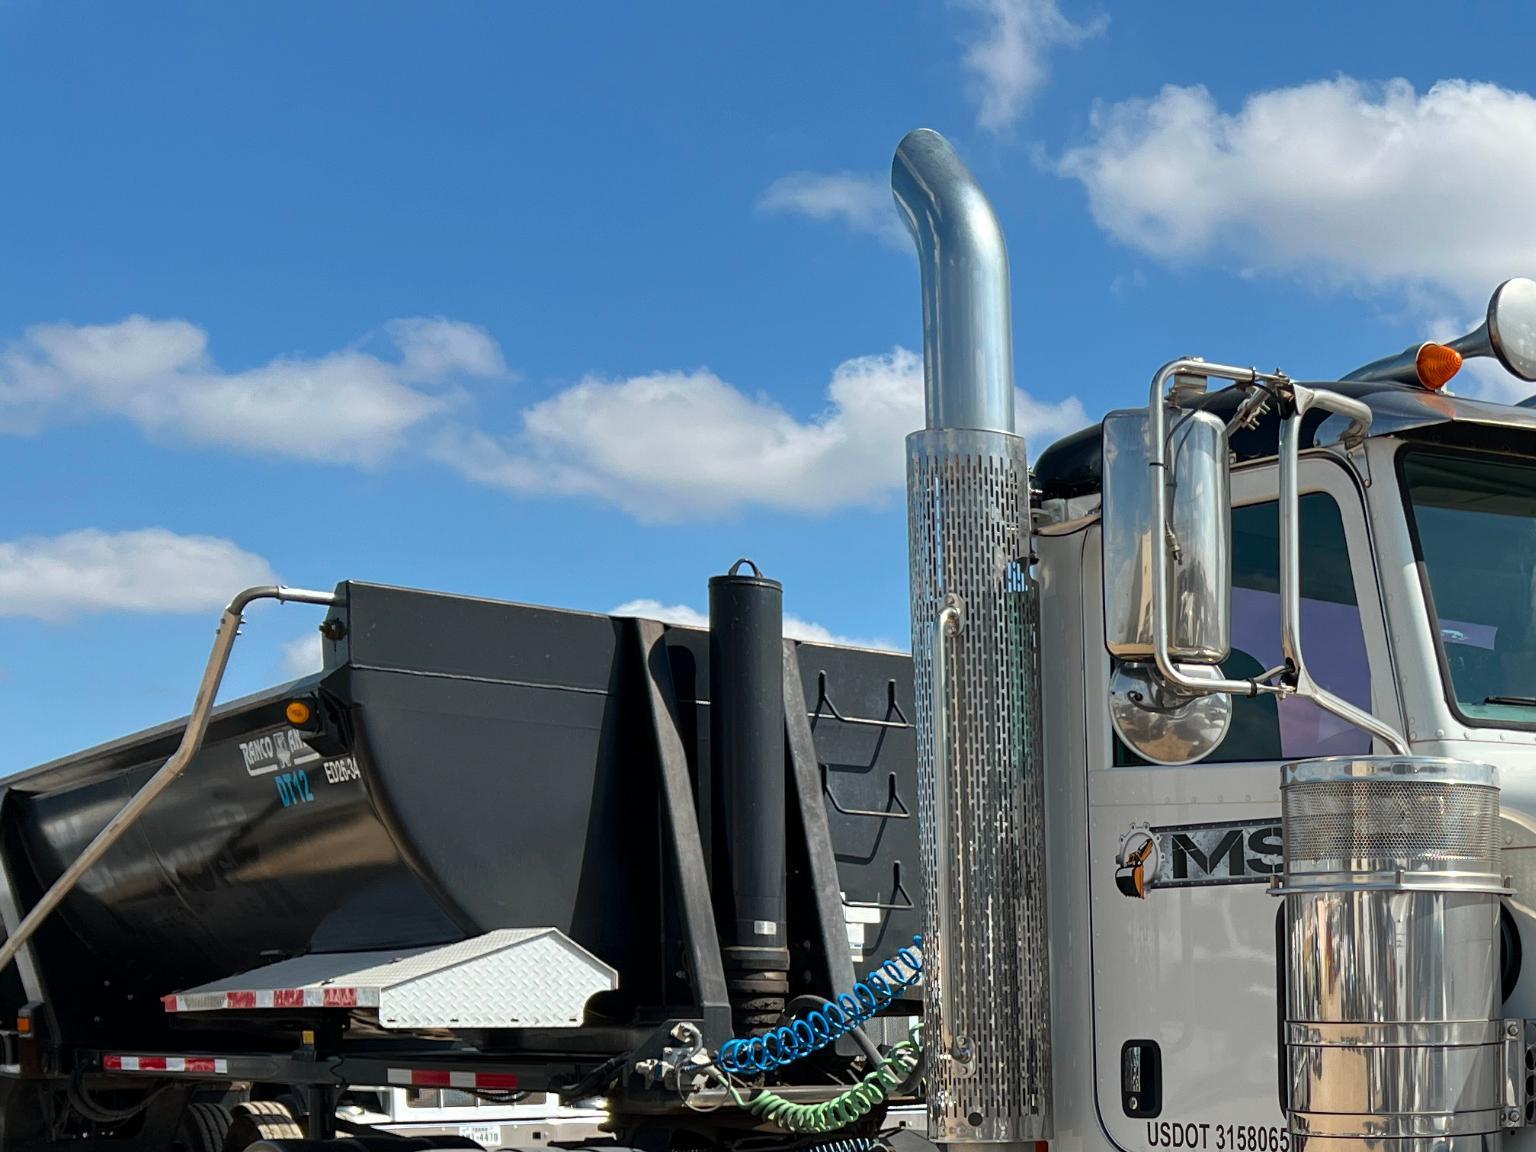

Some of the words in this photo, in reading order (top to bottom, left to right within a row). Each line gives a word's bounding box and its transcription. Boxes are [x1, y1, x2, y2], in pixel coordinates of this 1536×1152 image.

[239, 736, 274, 766] RANCO
[287, 729, 308, 753] AN
[274, 769, 315, 808] DT12
[1146, 1121, 1210, 1150] USDOT
